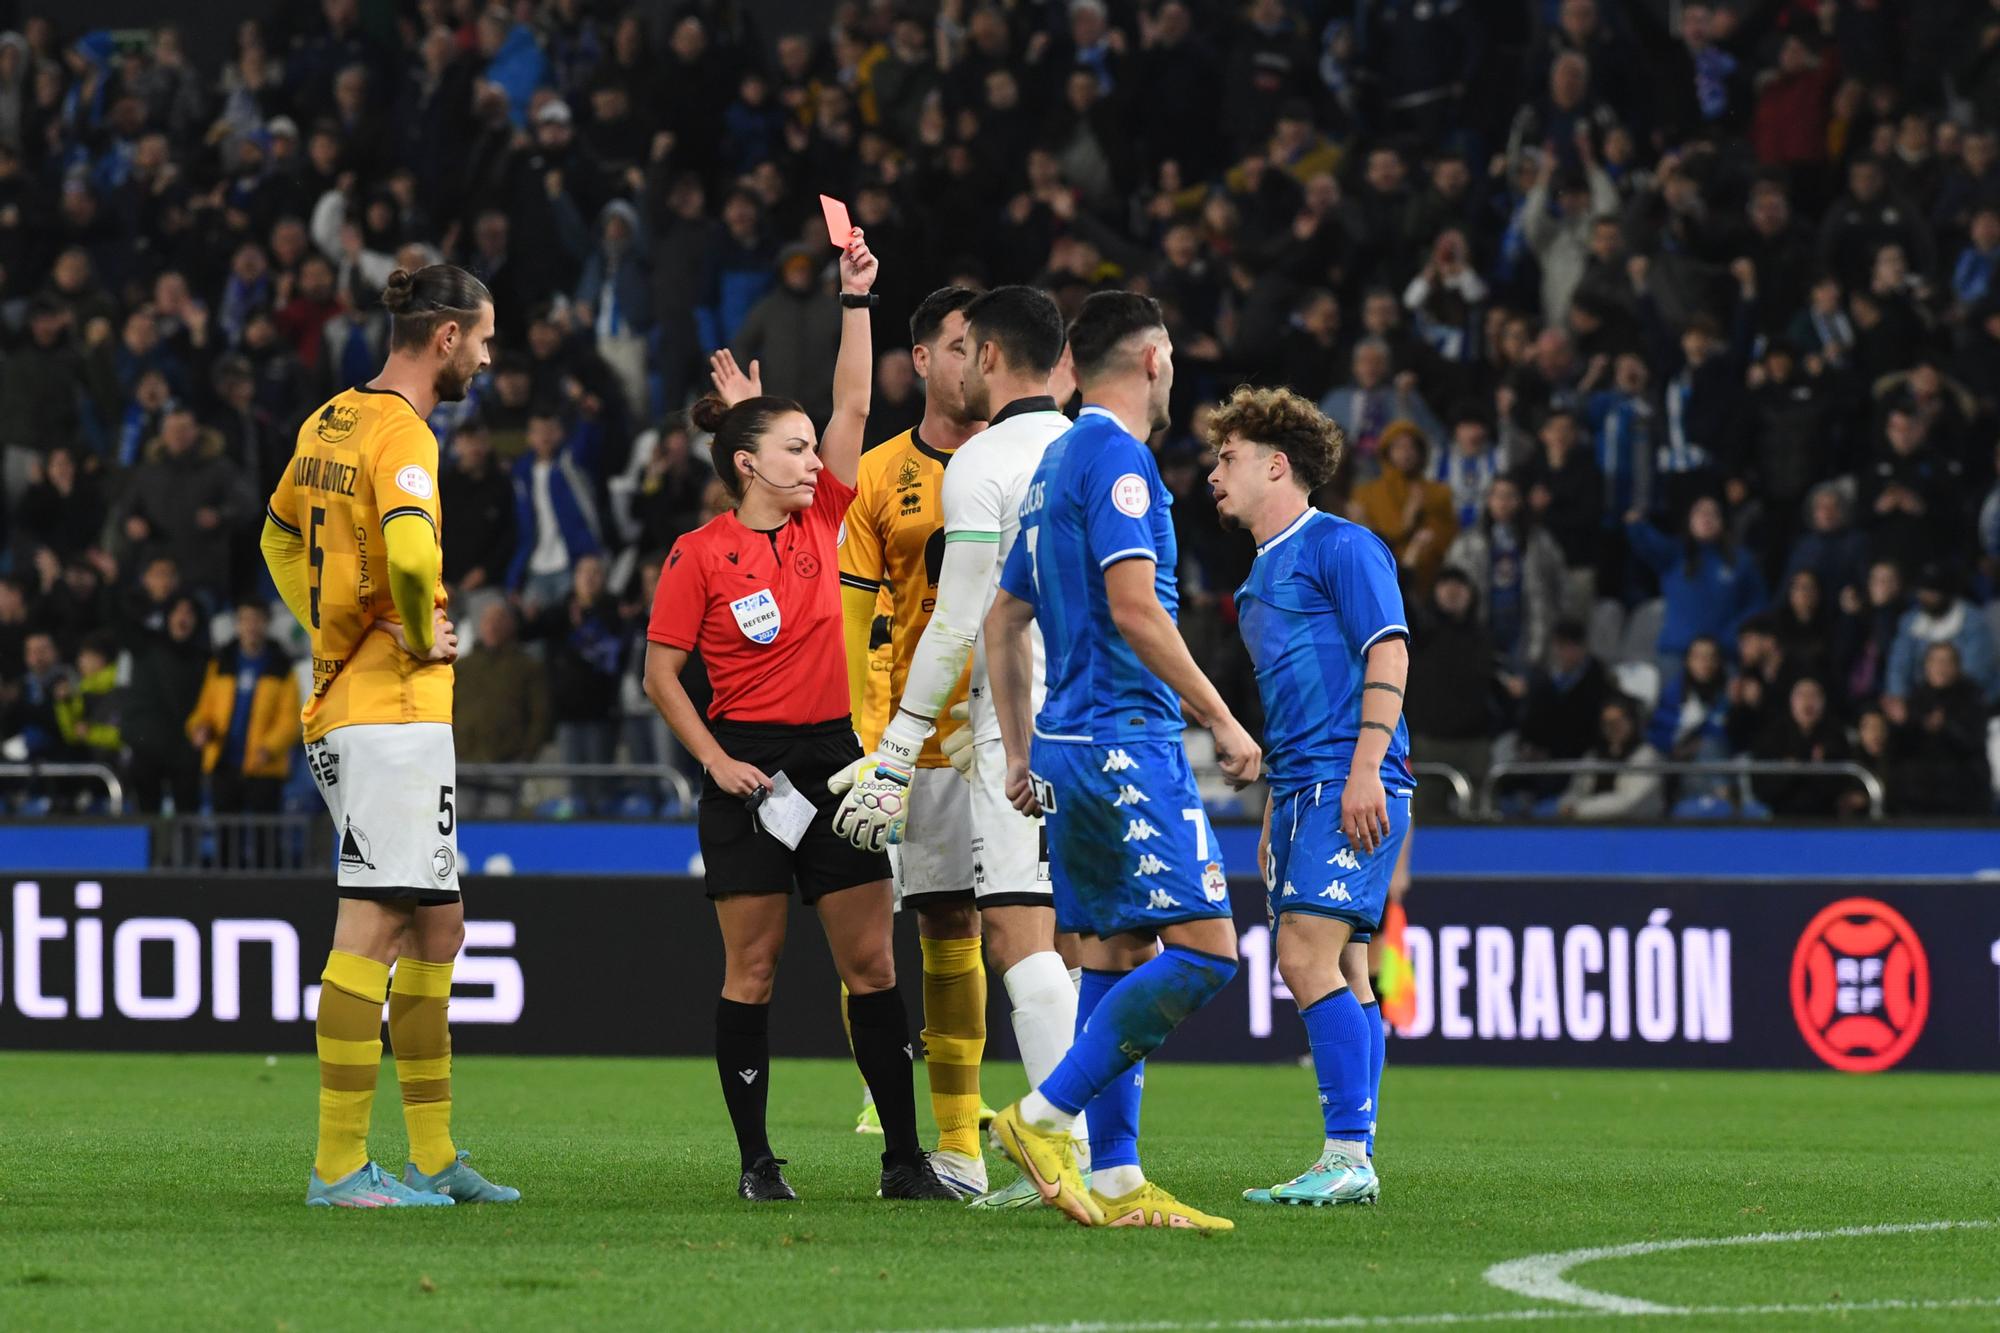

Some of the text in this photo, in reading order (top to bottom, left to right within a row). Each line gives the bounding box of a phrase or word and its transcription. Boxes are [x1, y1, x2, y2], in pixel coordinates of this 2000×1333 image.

[309, 506, 326, 629] 5
[1026, 525, 1040, 598] 7
[742, 610, 776, 629] REFEREE
[437, 786, 453, 836] 5
[1182, 808, 1208, 861] 7
[0, 881, 524, 1024] tion.s
[1384, 908, 1732, 1043] DERACIÓN
[1837, 958, 1882, 983] RF
[1838, 987, 1882, 1013] EF
